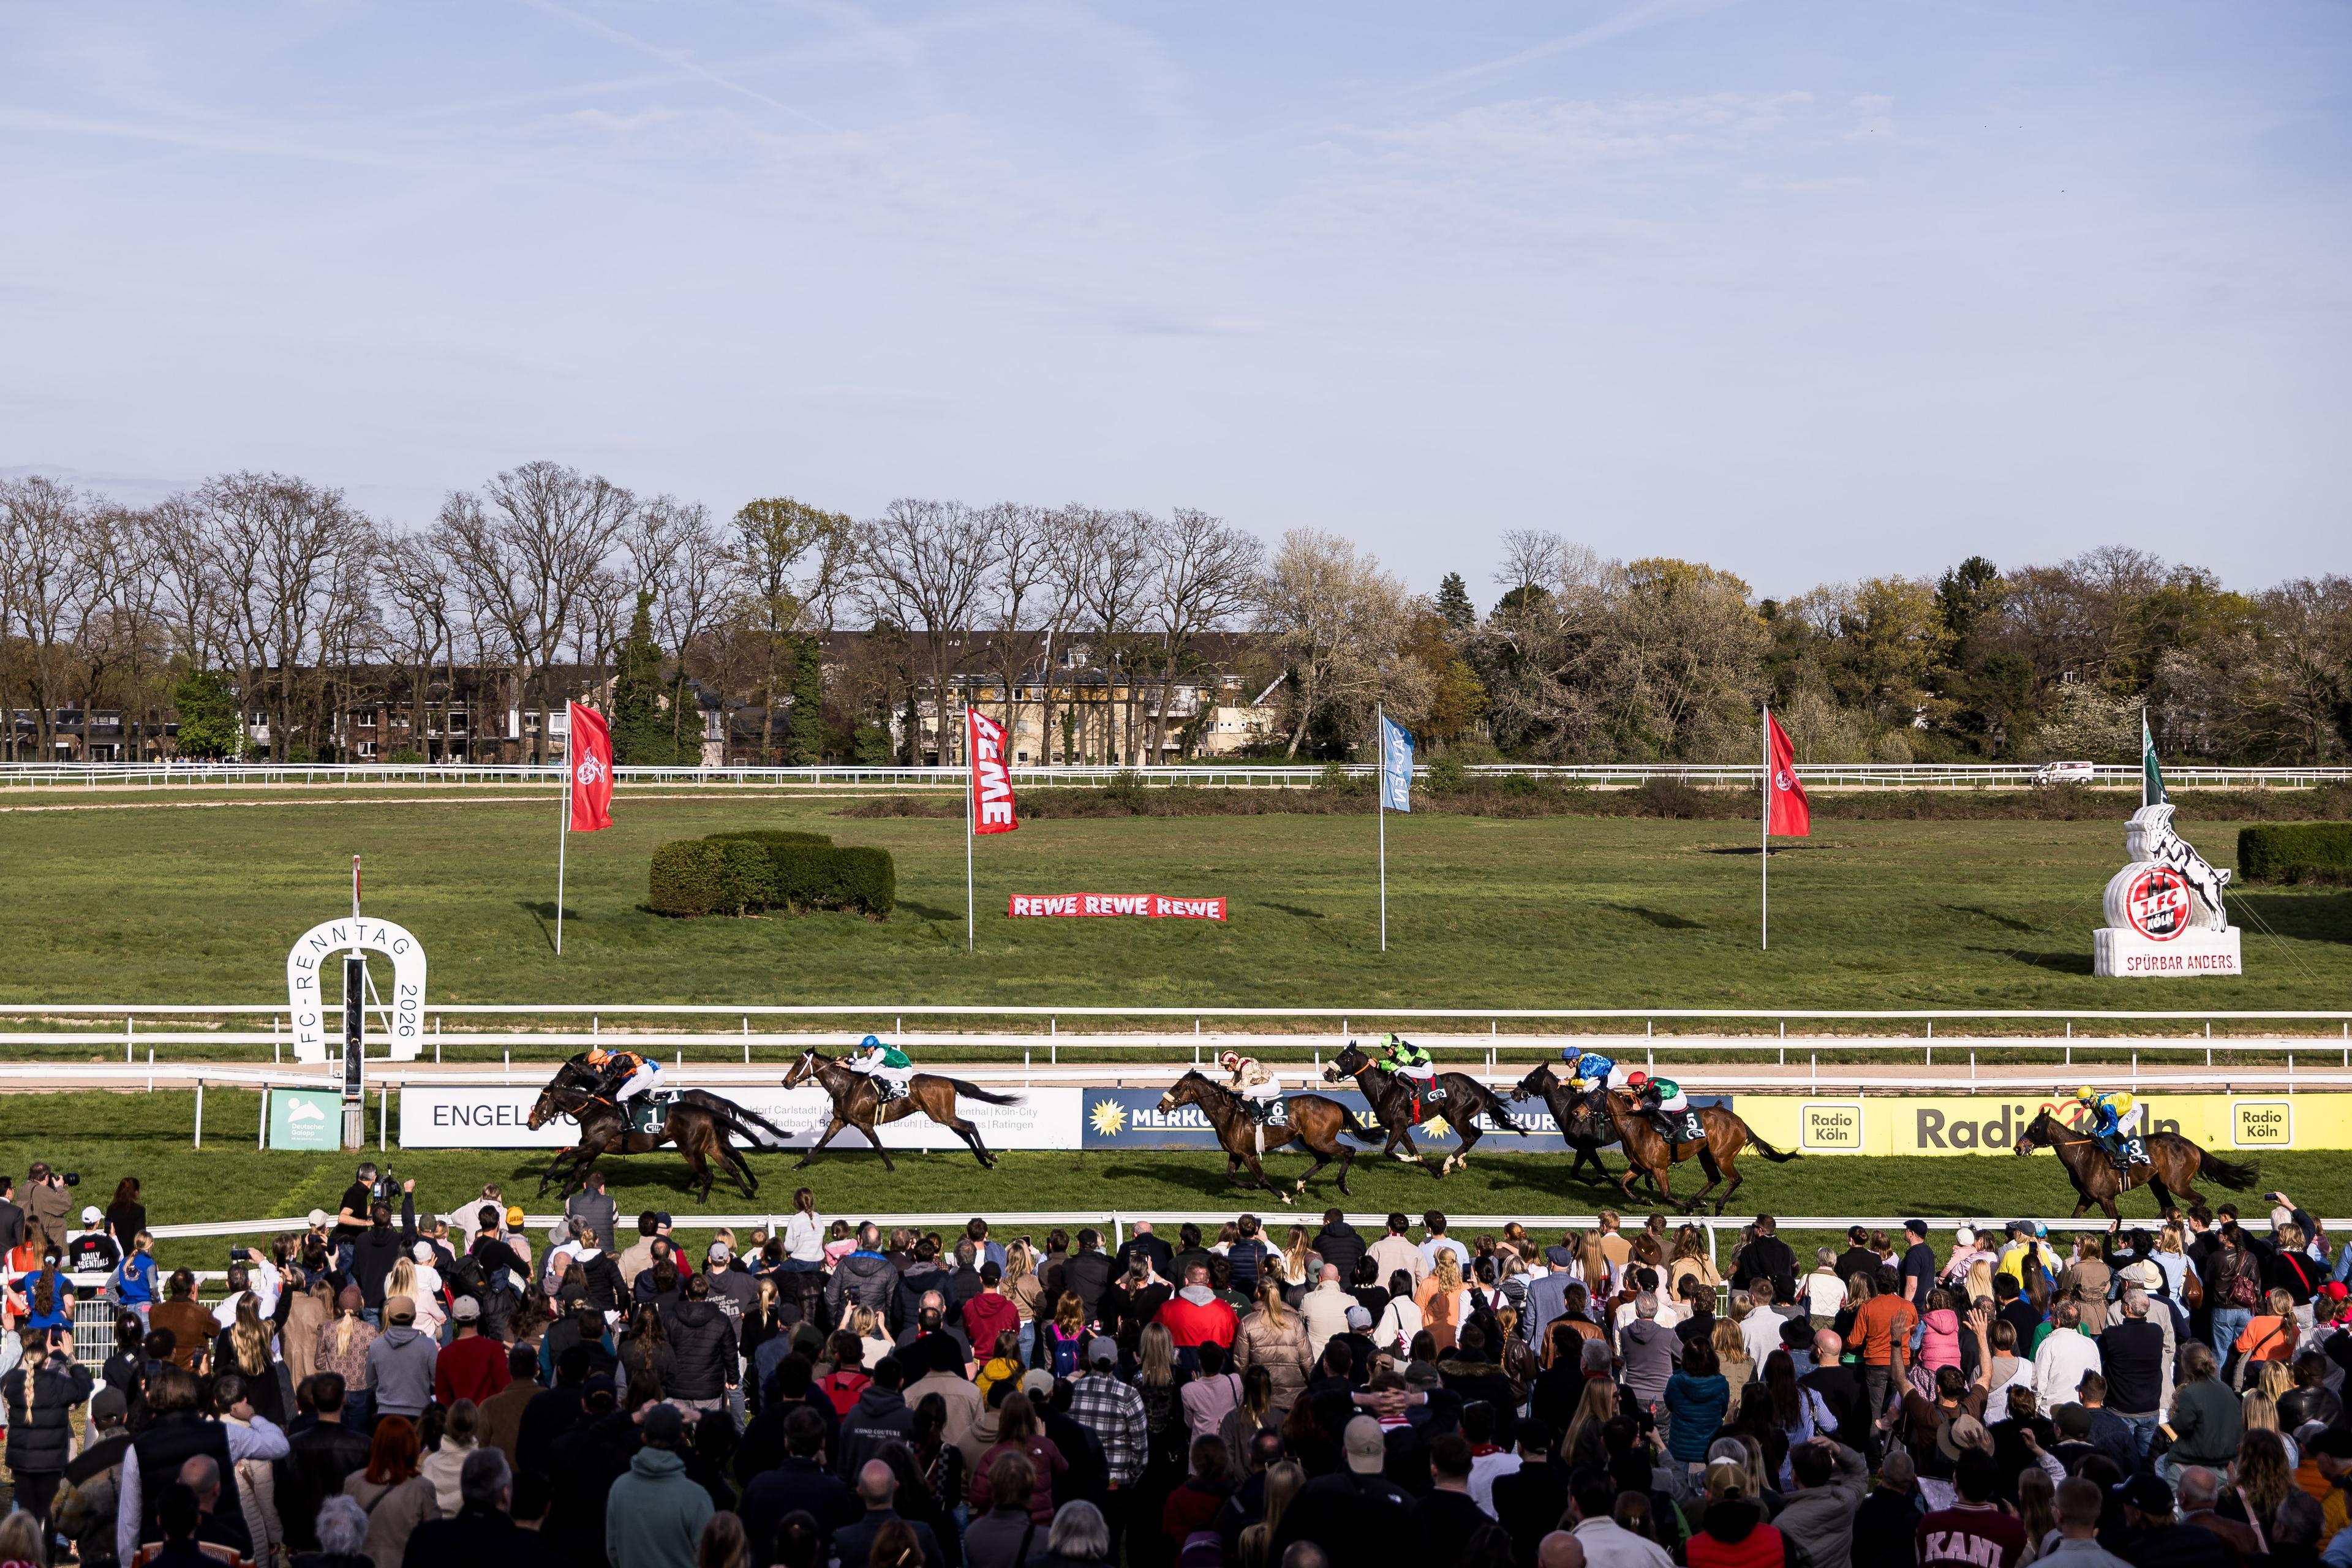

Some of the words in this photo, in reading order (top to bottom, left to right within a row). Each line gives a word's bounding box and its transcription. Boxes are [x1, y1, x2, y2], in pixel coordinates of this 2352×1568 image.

[1014, 896, 1077, 916] REWE
[1085, 896, 1148, 915] REWE
[1157, 898, 1221, 919] REWE
[2147, 912, 2174, 930] KÖLN
[2127, 954, 2182, 971] SPÜRBAR
[2187, 954, 2236, 970] ANDERS.
[399, 984, 418, 1037] 2026
[647, 1107, 657, 1123] 1
[774, 1105, 817, 1114] Carlstadt
[995, 1107, 1038, 1118] Köln-City
[1272, 1102, 1284, 1116] 6
[2243, 1110, 2282, 1123] Radio
[993, 1120, 1033, 1131] Ratingen
[1132, 1109, 1212, 1126] MERKU
[1686, 1113, 1697, 1129] 5
[1811, 1114, 1852, 1126] Radio
[1816, 1128, 1848, 1140] Köln
[1917, 1104, 2024, 1148] Radi
[2247, 1125, 2277, 1137] Köln
[2128, 1139, 2143, 1156] 3
[81, 1251, 100, 1261] DAILY
[1925, 1531, 2003, 1568] KANI
